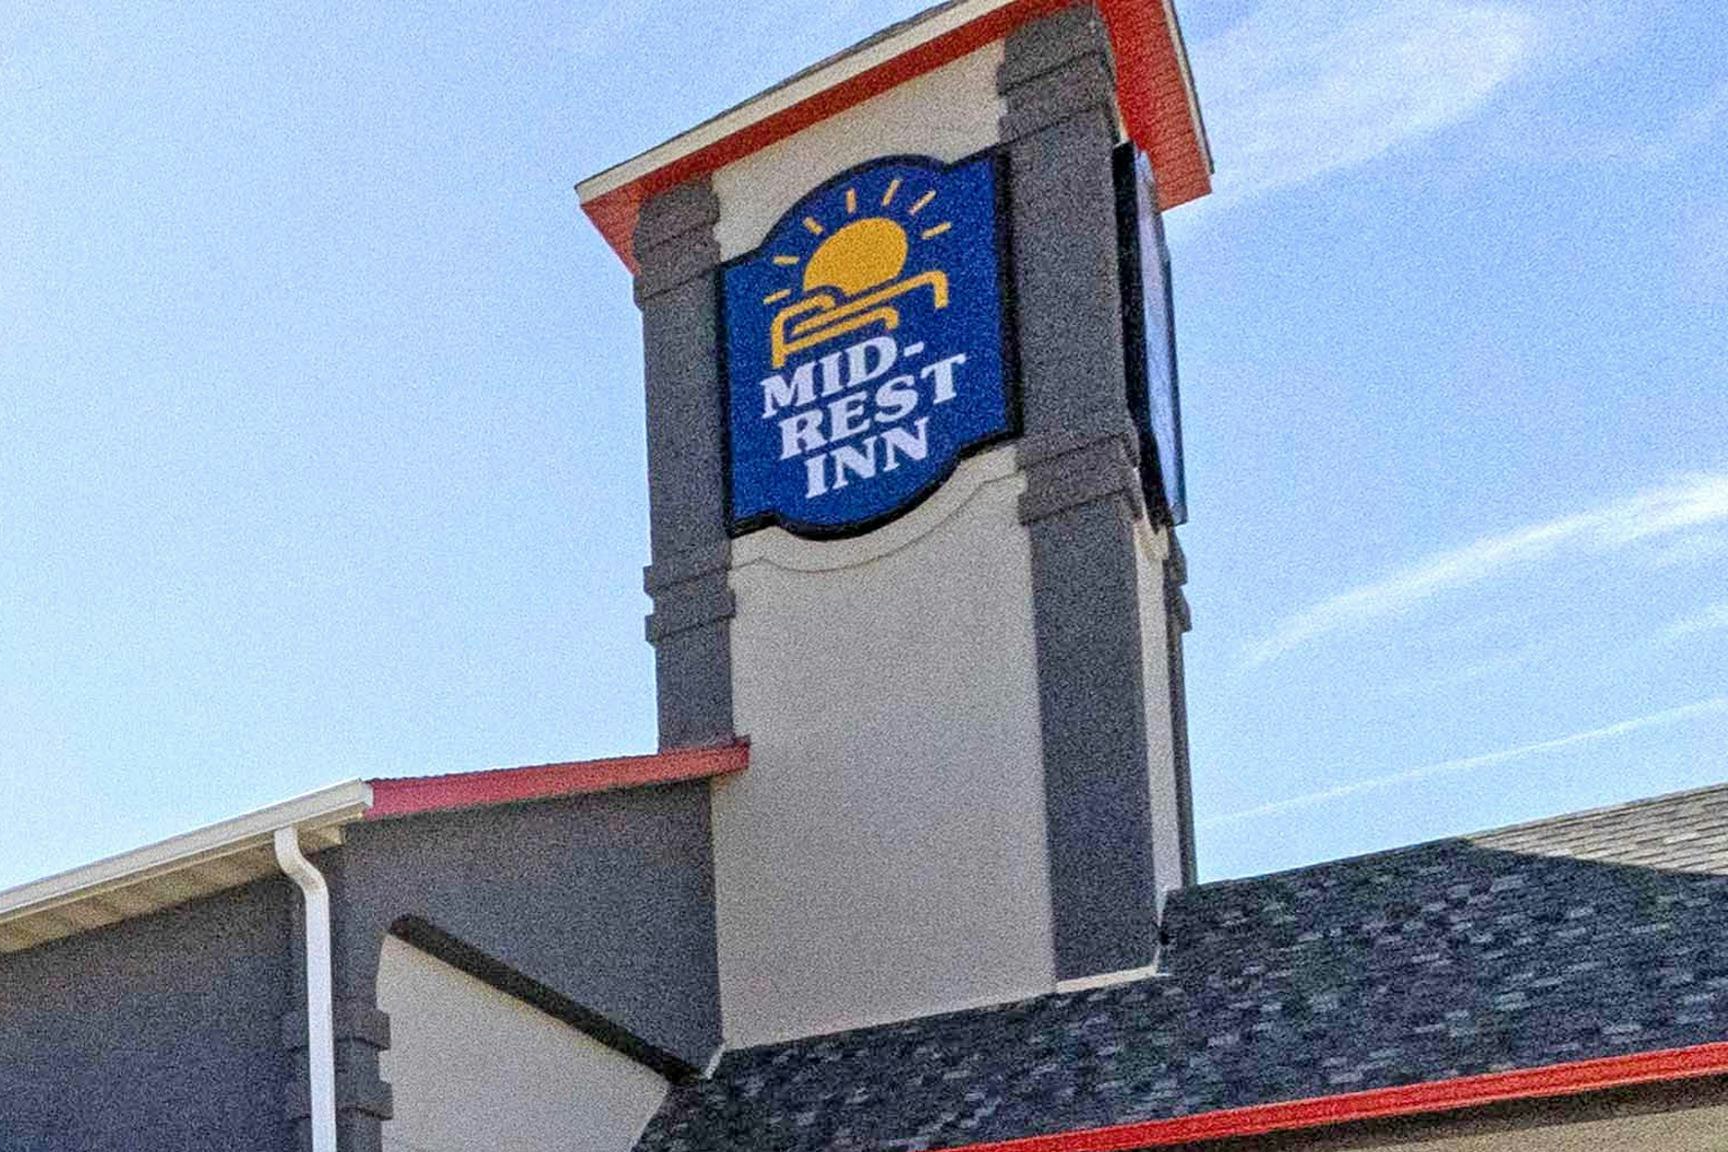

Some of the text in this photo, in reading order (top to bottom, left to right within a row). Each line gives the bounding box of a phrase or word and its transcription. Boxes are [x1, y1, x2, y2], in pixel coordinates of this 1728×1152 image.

[759, 336, 925, 419] MID-
[778, 354, 966, 460] REST
[804, 418, 928, 499] INN
